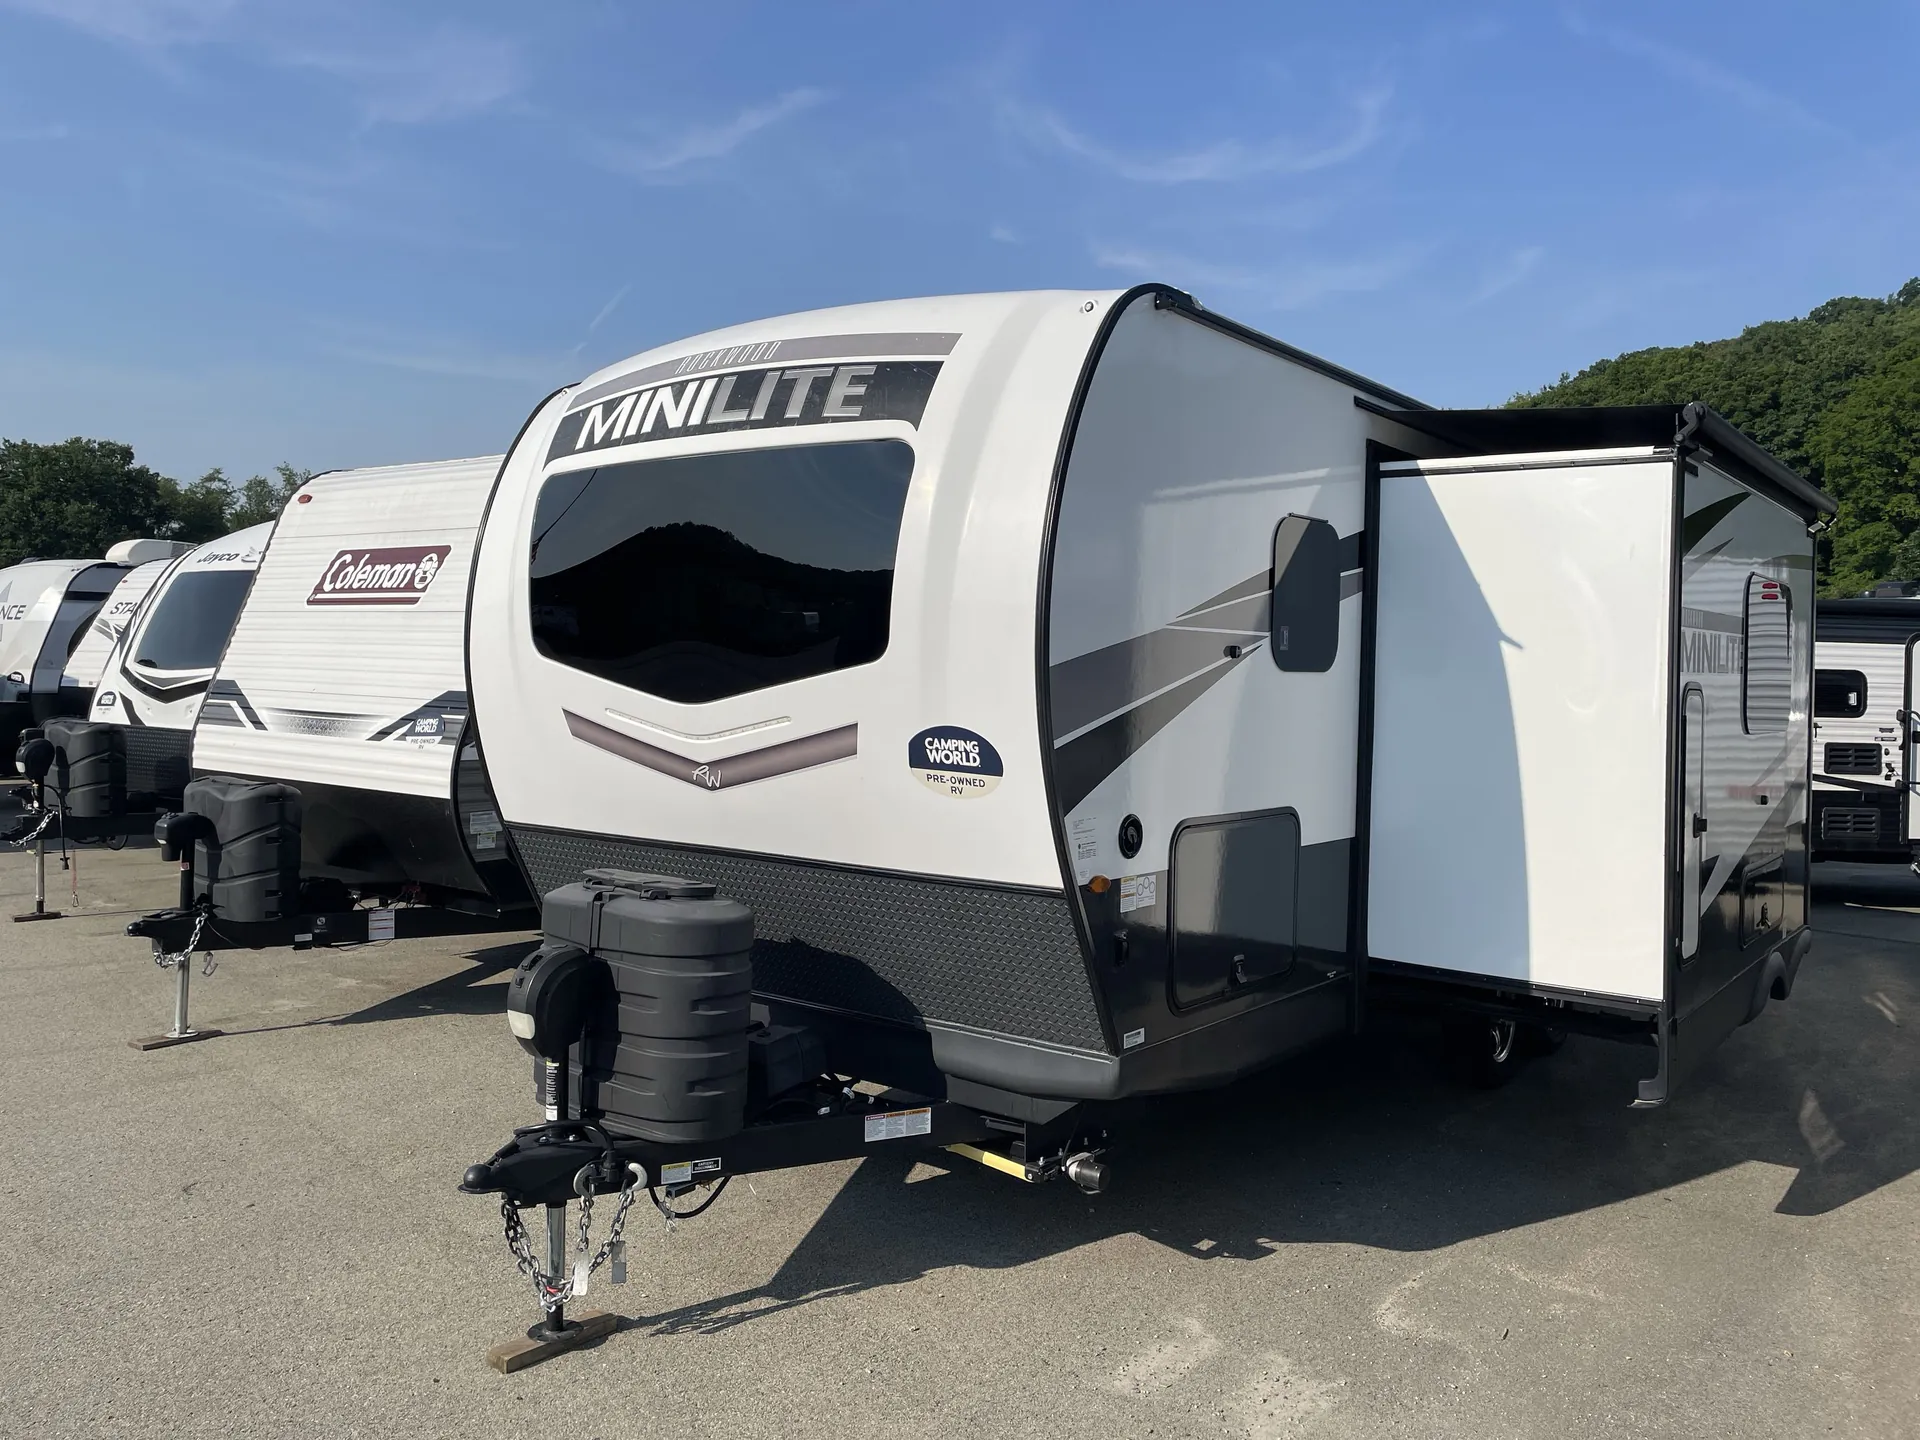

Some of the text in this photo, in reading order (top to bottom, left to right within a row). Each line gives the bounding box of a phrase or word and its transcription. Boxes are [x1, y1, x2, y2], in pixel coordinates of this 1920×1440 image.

[675, 341, 781, 374] ROCKWOOD
[196, 551, 241, 564] Jayco
[322, 553, 417, 593] Coleman
[924, 737, 979, 753] CAMPING
[926, 773, 986, 788] PRE-OWNED
[950, 786, 963, 795] RV
